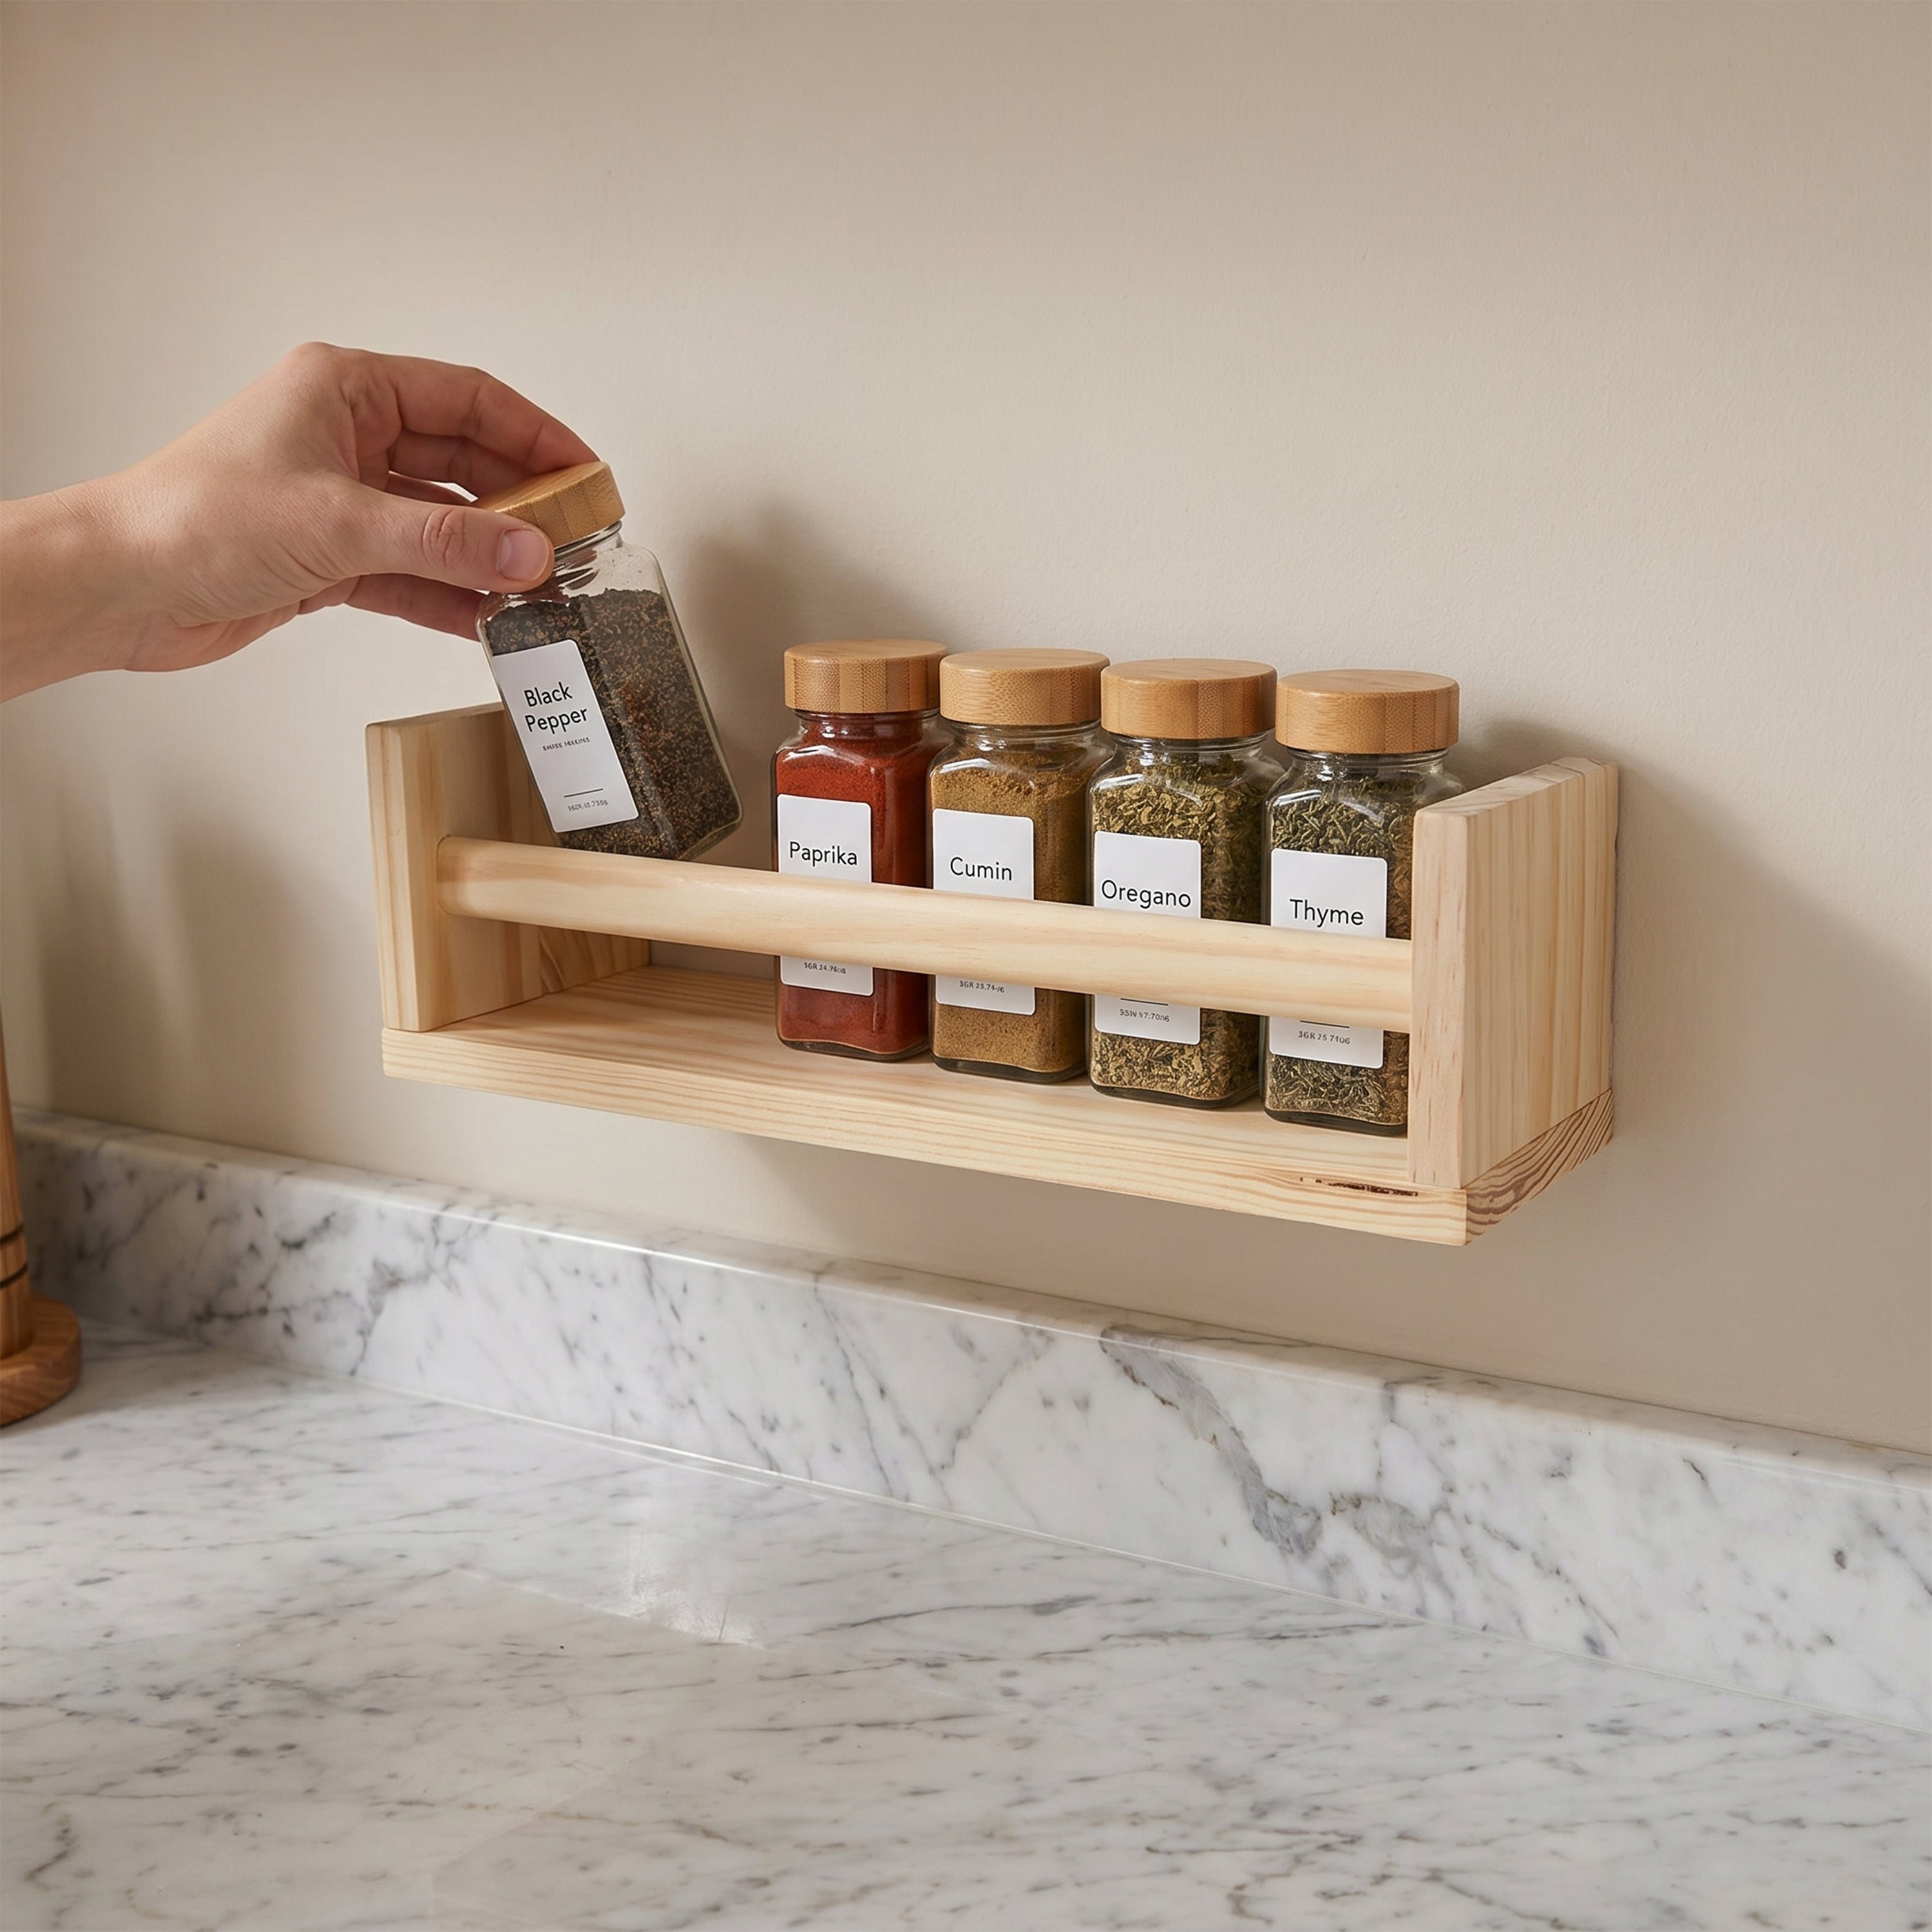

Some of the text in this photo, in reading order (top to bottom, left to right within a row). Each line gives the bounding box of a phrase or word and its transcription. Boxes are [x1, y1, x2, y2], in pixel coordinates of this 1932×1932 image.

[524, 681, 573, 707] Black
[524, 708, 587, 734] Pepper
[790, 841, 857, 867] Paprika
[950, 857, 1012, 881] Cumin
[1101, 880, 1191, 909] Oregano
[1289, 898, 1364, 928] Thyme
